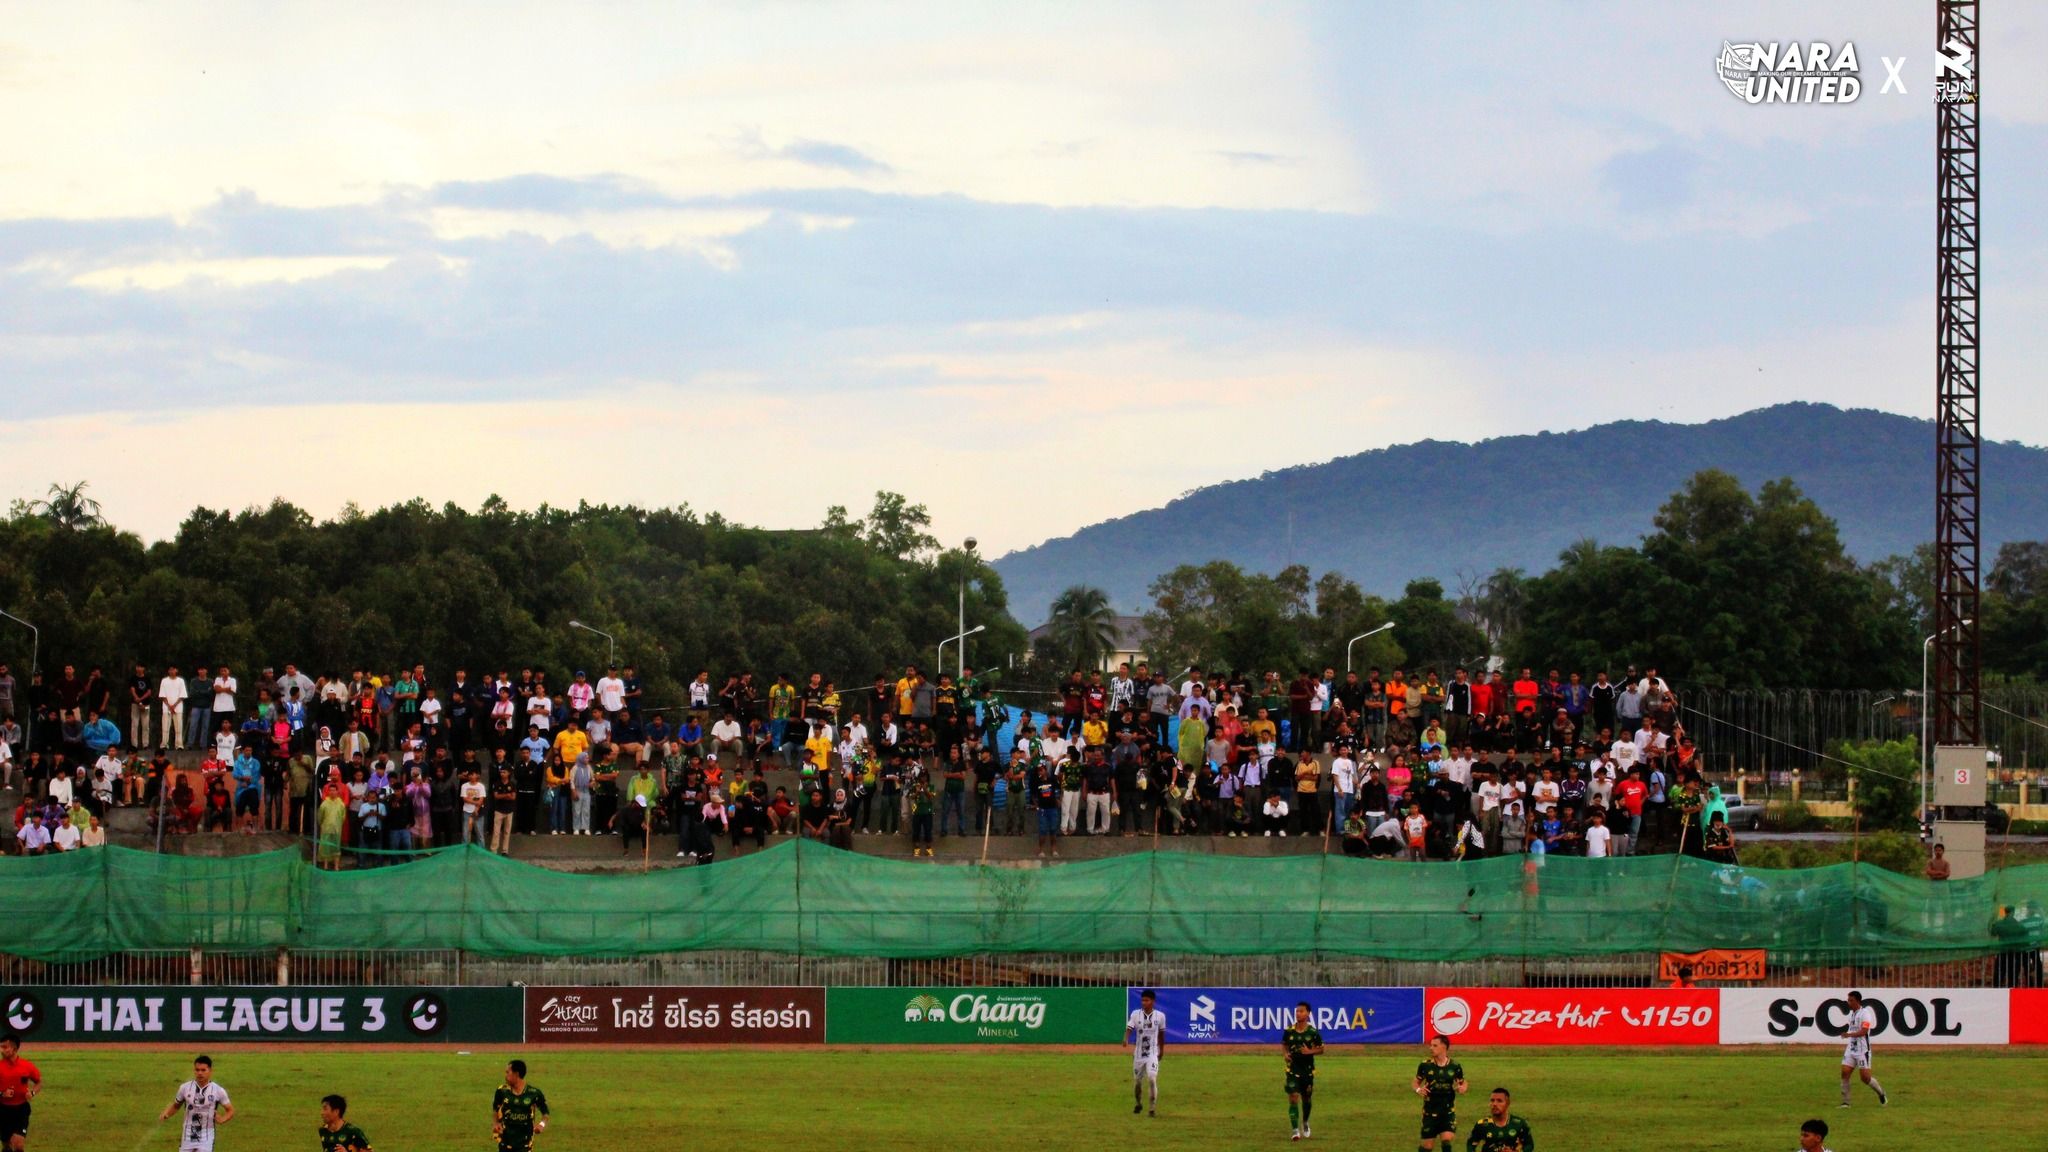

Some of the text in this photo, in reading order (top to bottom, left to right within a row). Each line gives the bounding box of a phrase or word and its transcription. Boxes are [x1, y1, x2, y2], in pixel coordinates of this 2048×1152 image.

[1957, 770, 1967, 783] 3
[58, 998, 386, 1031] THAI LEAGUE 3
[731, 1002, 810, 1028] รีสอร์ท
[949, 994, 1047, 1029] Chang
[1478, 1002, 1712, 1030] Pizza Hut 1150
[1768, 998, 1962, 1037] S-COOL
[977, 1026, 1019, 1038] MINERAL
